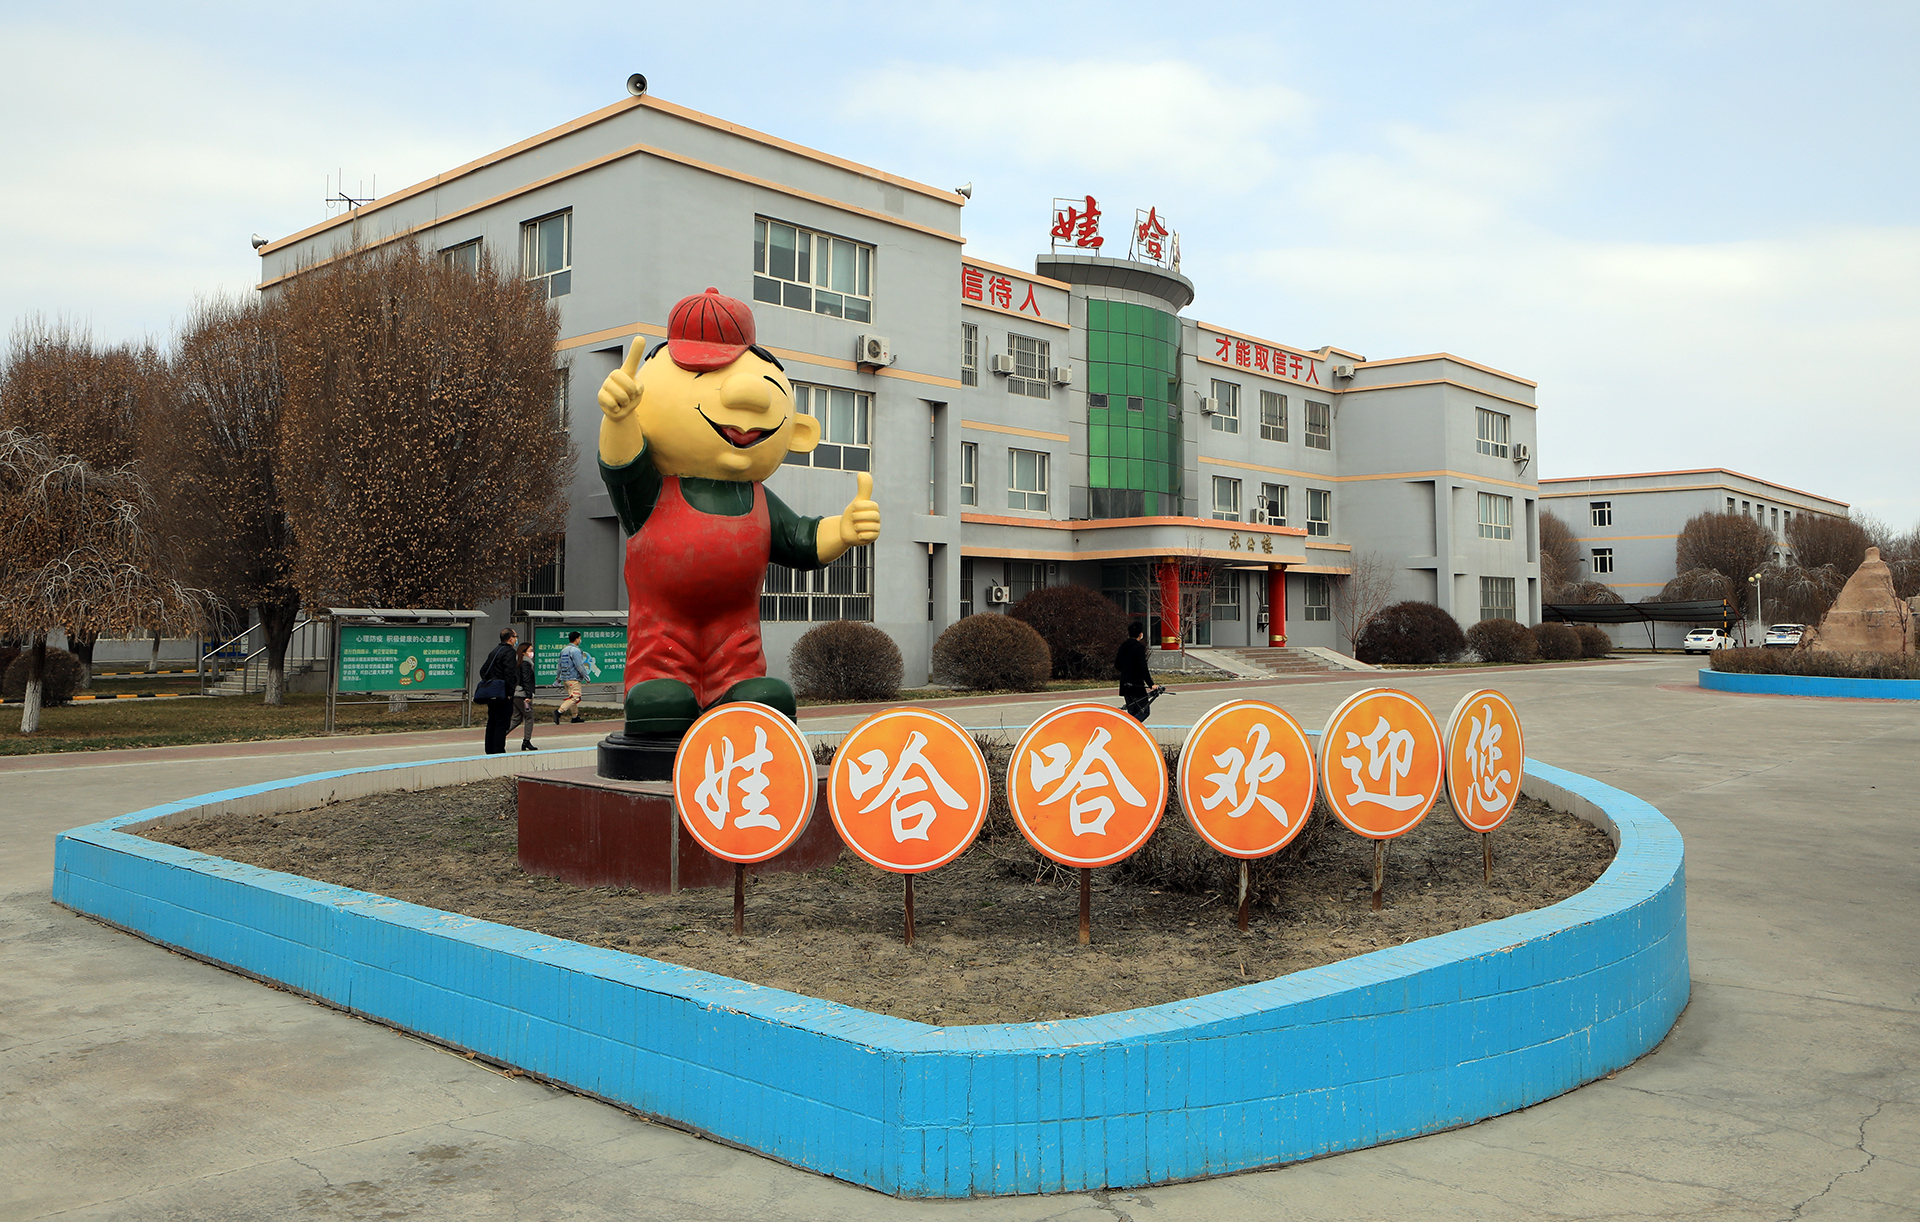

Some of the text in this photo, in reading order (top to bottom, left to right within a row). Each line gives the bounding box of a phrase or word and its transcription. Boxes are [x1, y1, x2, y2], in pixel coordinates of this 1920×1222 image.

[961, 266, 1041, 317] 信待人
[1215, 336, 1319, 385] 才能取信于人
